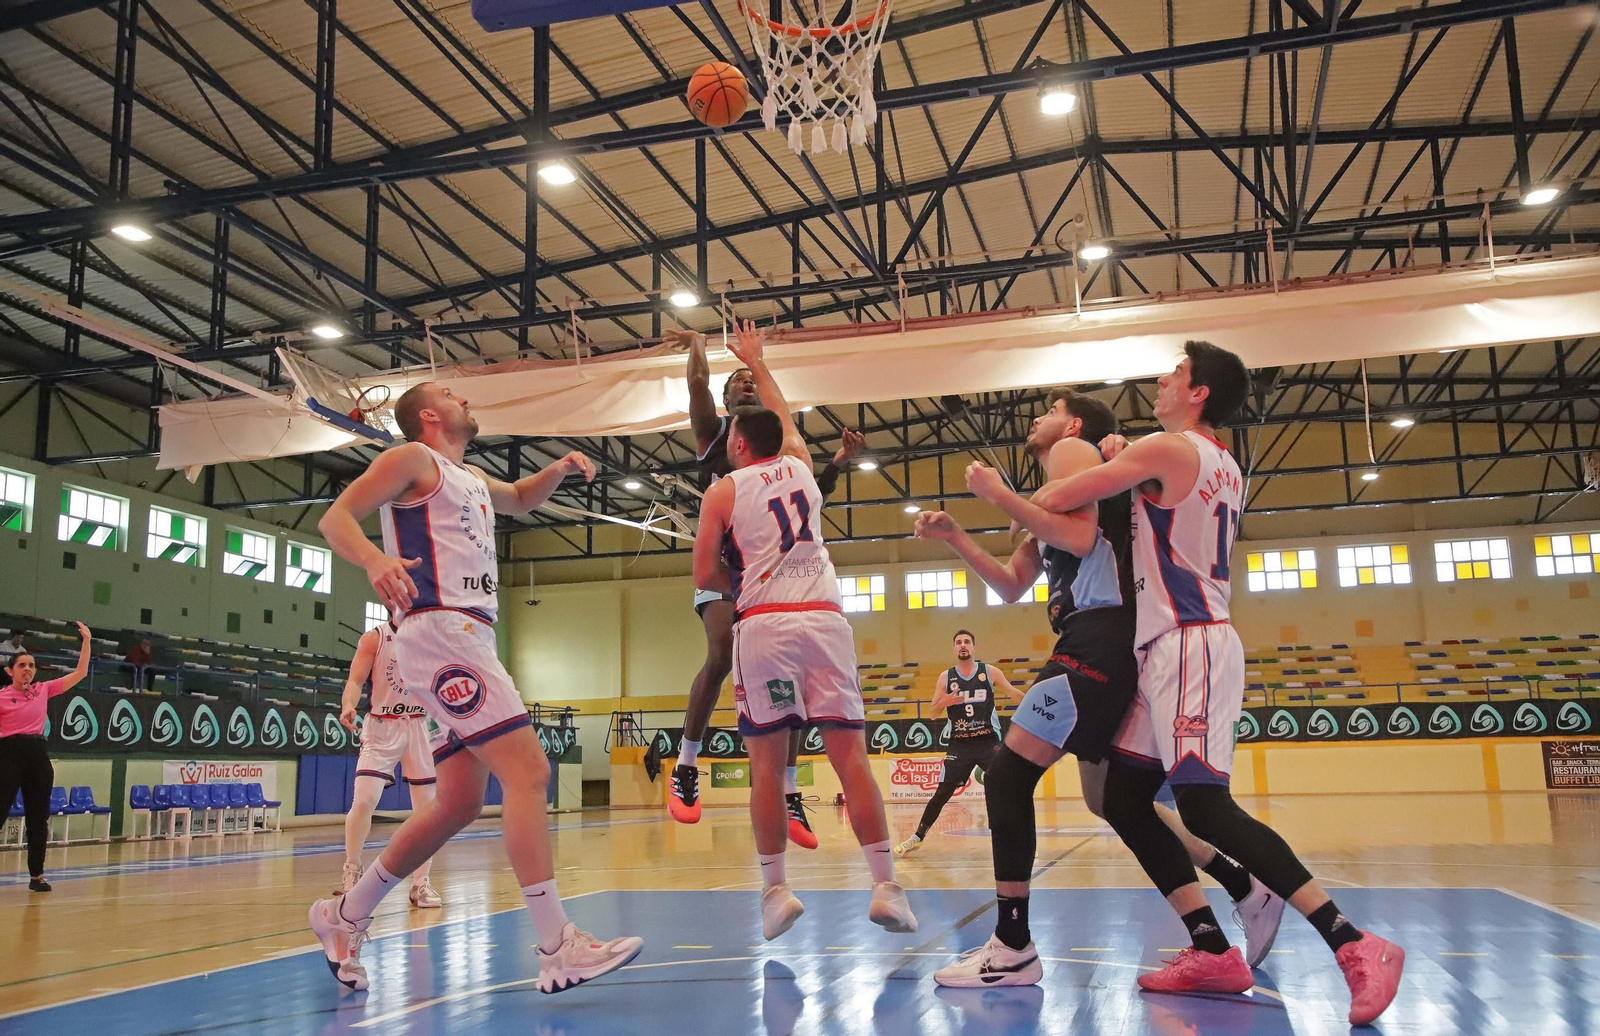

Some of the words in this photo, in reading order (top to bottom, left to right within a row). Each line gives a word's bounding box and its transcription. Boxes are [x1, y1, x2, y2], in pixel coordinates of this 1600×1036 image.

[760, 466, 793, 486] RUI
[768, 488, 814, 554] 11
[965, 704, 975, 717] 9
[1032, 703, 1055, 721] vive
[208, 764, 229, 778] Ruiz
[232, 764, 263, 778] Galán
[900, 759, 940, 774] Compa
[894, 773, 907, 783] de
[910, 772, 928, 783] las
[1554, 776, 1585, 784] BUFFET
